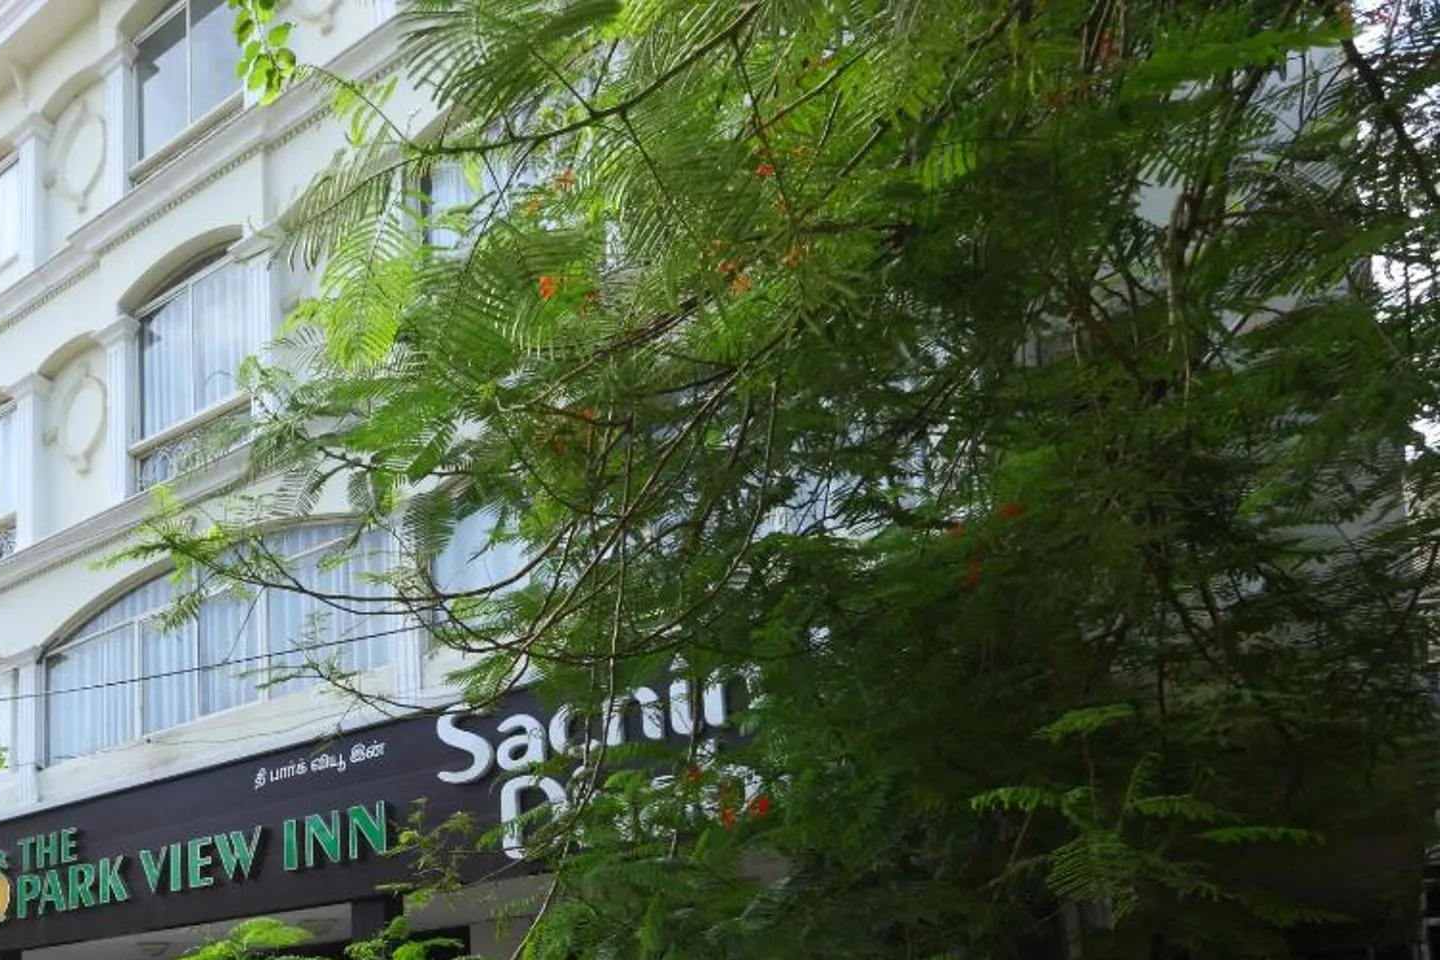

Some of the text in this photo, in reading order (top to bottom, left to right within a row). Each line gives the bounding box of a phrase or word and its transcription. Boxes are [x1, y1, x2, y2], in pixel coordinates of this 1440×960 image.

[349, 740, 386, 763] இன்
[16, 800, 386, 919] PARK VIEW INN
[17, 827, 79, 871] THE
